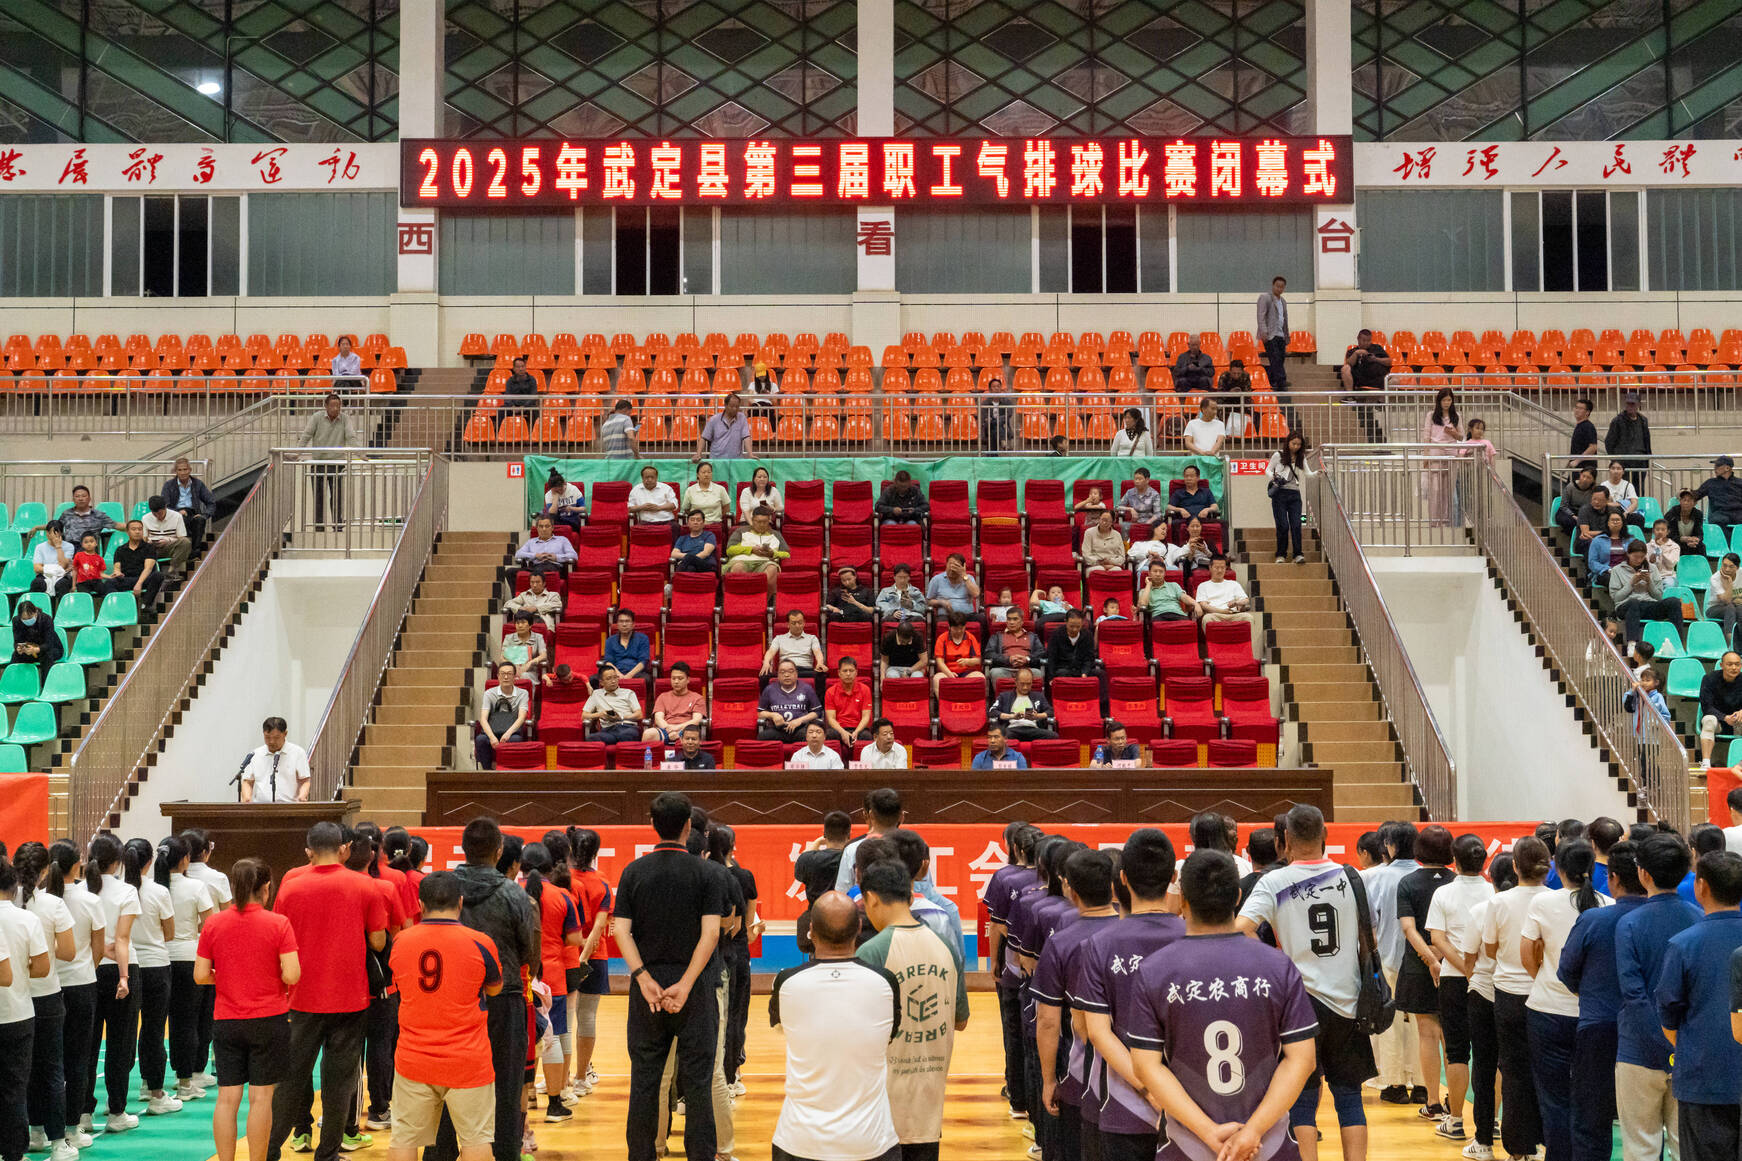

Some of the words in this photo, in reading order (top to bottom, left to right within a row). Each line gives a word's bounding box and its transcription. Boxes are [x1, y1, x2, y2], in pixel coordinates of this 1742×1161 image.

[418, 140, 1337, 199] 2025年武定县第三届职工气排球比赛闭幕式
[397, 222, 435, 256] 西
[857, 220, 895, 257] 看
[1316, 218, 1355, 254] 台
[1289, 877, 1347, 901] 武定一中
[1307, 902, 1341, 958] 9
[418, 949, 443, 994] 9
[895, 963, 949, 985] BREAK
[1166, 975, 1272, 1005] 武定农商行
[1203, 1019, 1246, 1097] 8
